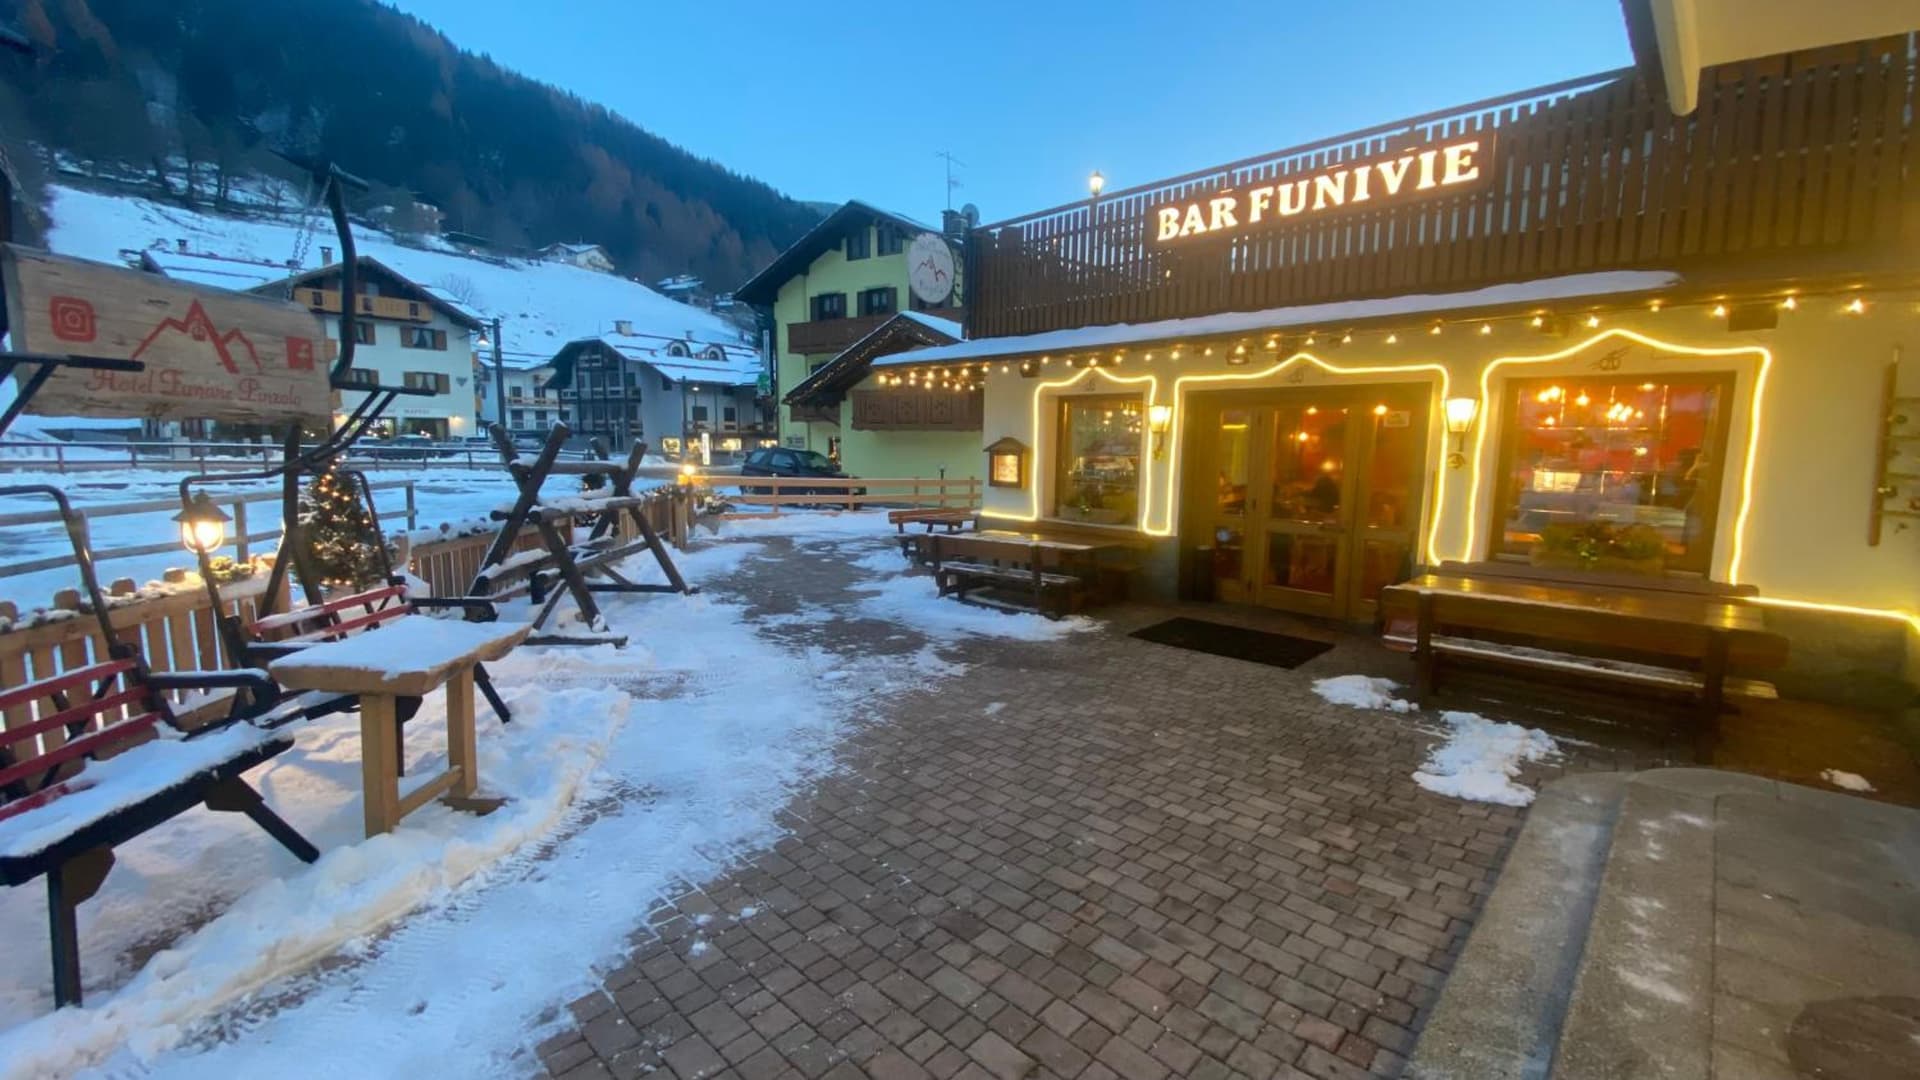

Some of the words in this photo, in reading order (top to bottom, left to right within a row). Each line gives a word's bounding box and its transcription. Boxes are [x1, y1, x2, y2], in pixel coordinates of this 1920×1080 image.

[1157, 197, 1238, 241] BAR
[1248, 142, 1479, 223] FUNIVIE
[85, 368, 153, 394] Hotel
[238, 377, 302, 406] Pinzolo
